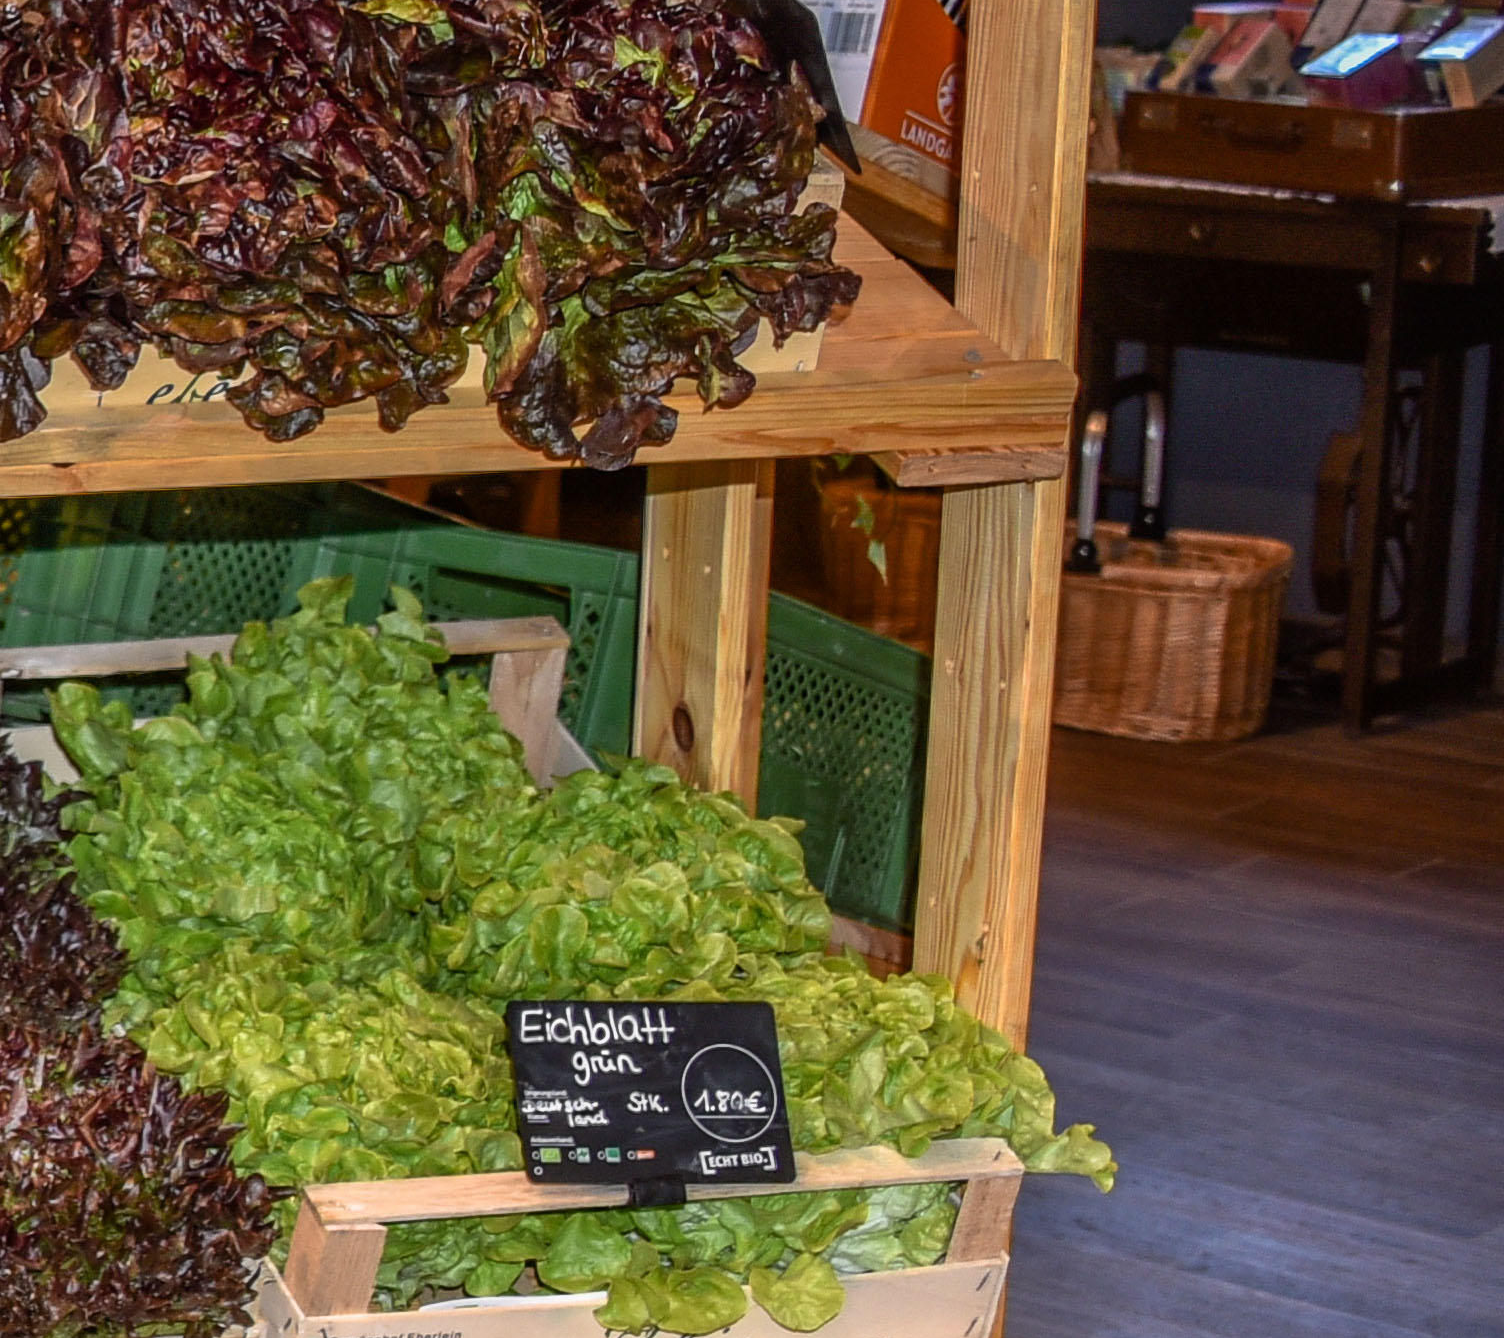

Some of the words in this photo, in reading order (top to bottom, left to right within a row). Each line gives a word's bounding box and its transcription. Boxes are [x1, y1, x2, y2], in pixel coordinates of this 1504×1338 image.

[520, 1007, 675, 1045] Eichblatt
[572, 1050, 642, 1086] grün
[568, 1112, 609, 1127] land
